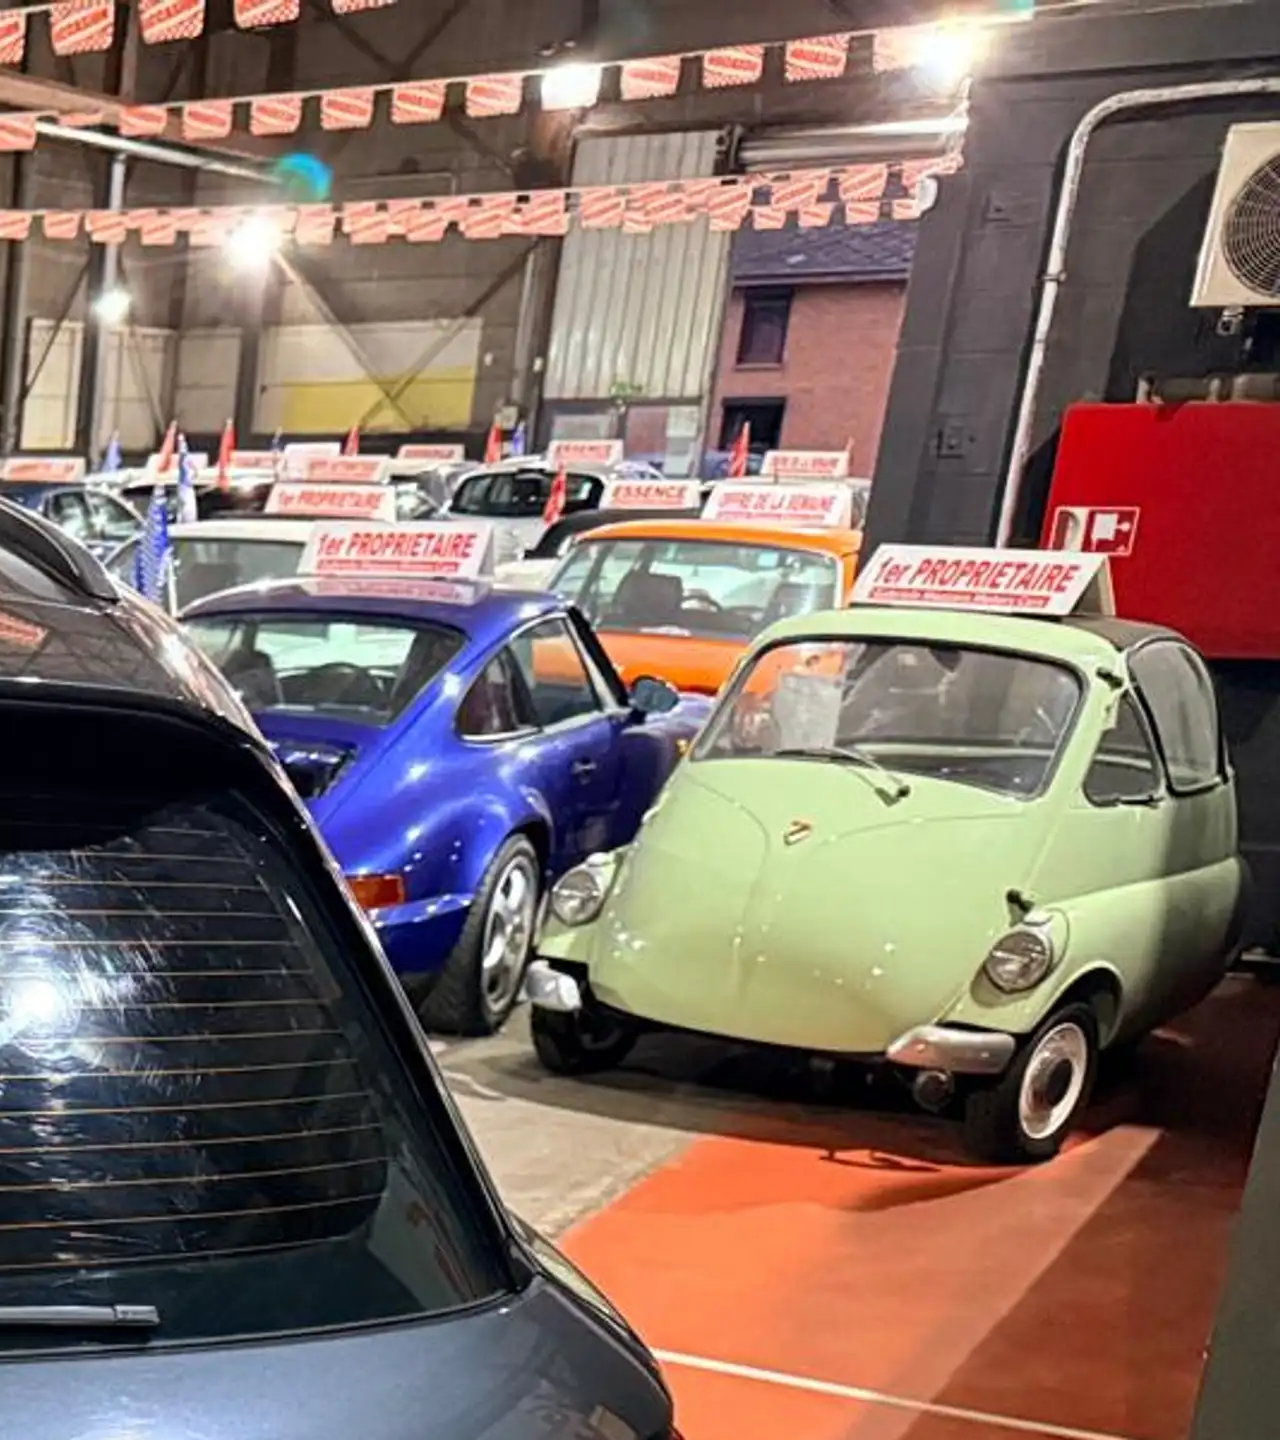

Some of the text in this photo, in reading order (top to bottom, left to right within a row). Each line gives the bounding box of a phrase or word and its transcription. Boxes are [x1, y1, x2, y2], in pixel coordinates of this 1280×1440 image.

[611, 484, 687, 502] ESSENCE
[316, 531, 477, 559] 1er PROPRIETAIRE
[873, 556, 1082, 593] 1er PROPRIETAIRE
